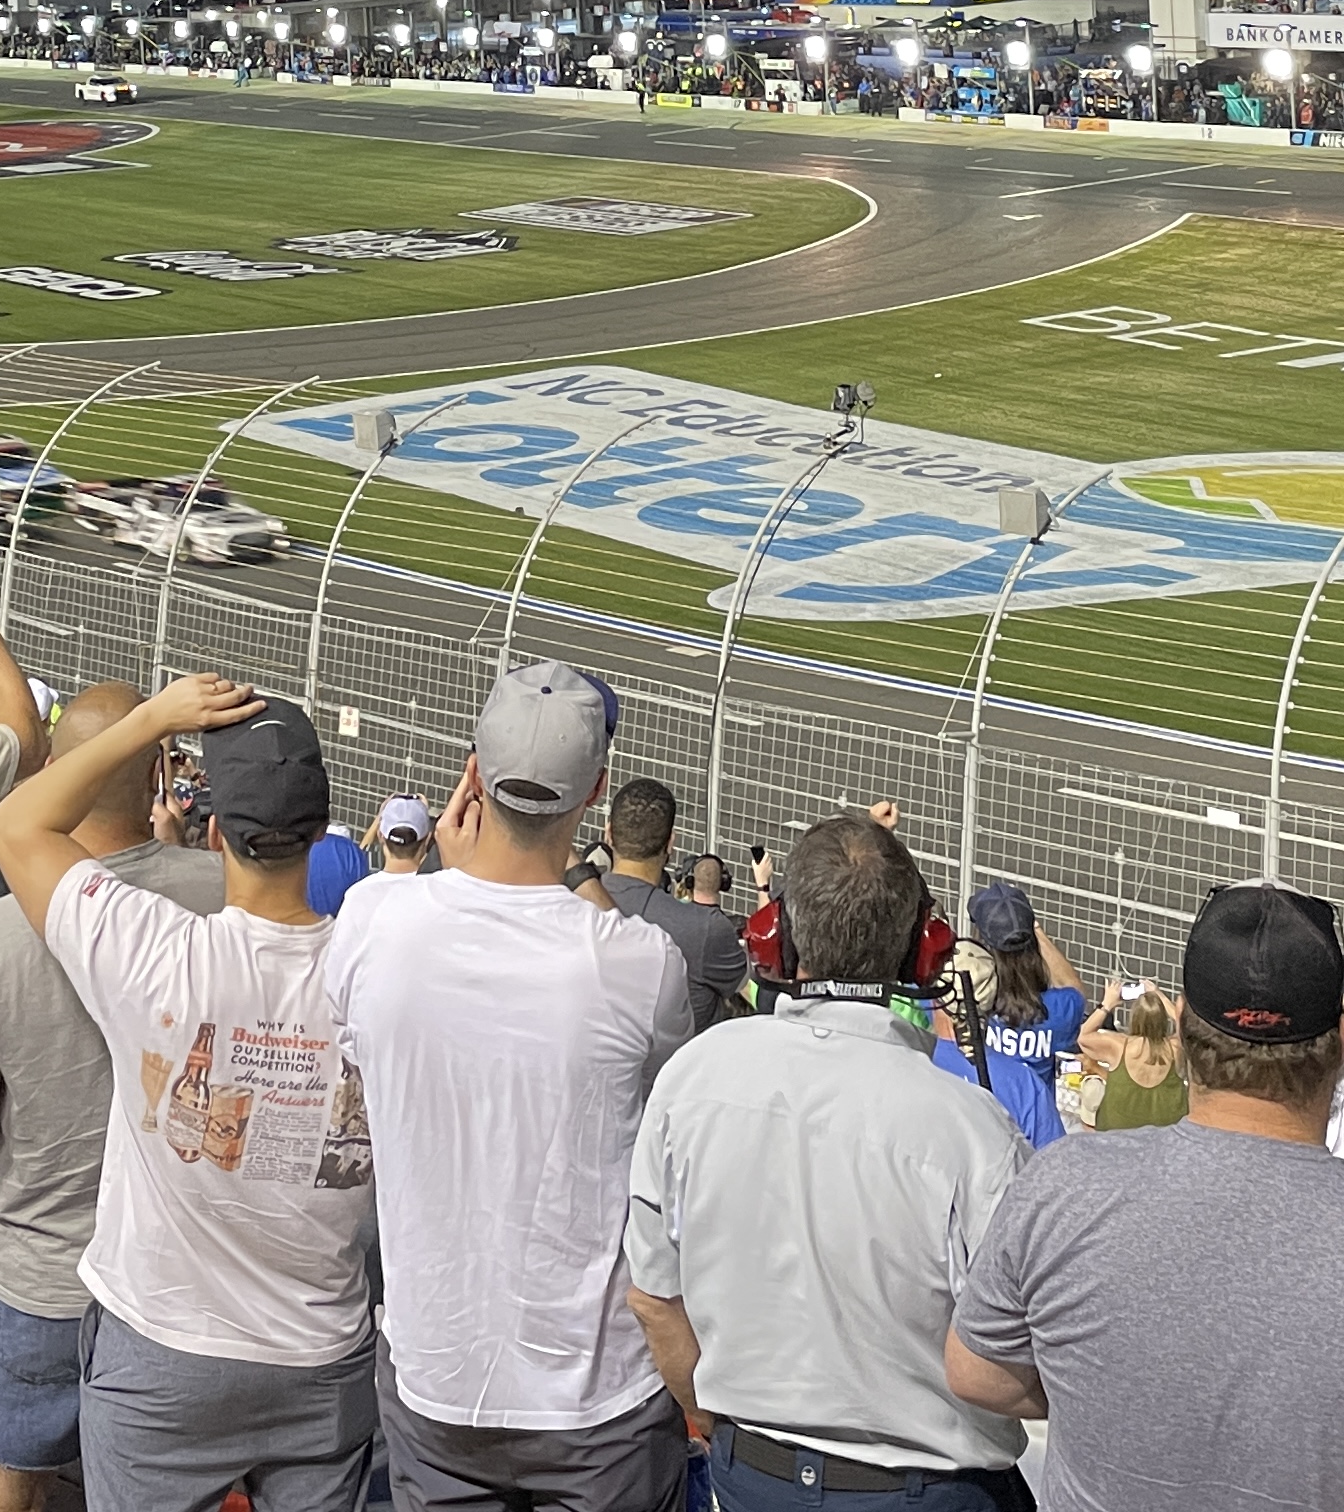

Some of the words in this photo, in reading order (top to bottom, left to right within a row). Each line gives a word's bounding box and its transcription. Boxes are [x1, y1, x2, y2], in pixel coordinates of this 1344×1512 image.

[1226, 28, 1268, 43] BANK
[1273, 29, 1291, 44] O
[505, 373, 662, 405] NC
[801, 981, 829, 997] RACING
[834, 983, 883, 998] ELECTRONICS
[257, 1019, 285, 1032] WHY
[293, 1023, 305, 1034] IS
[229, 1026, 329, 1051] Budweiser
[986, 1026, 1052, 1058] NSON
[233, 1044, 316, 1062] OUTSELLING
[230, 1055, 321, 1074] COMPETITION?
[234, 1070, 275, 1088] Here
[278, 1080, 302, 1091] are
[305, 1075, 328, 1091] the
[261, 1089, 325, 1107] Answers
